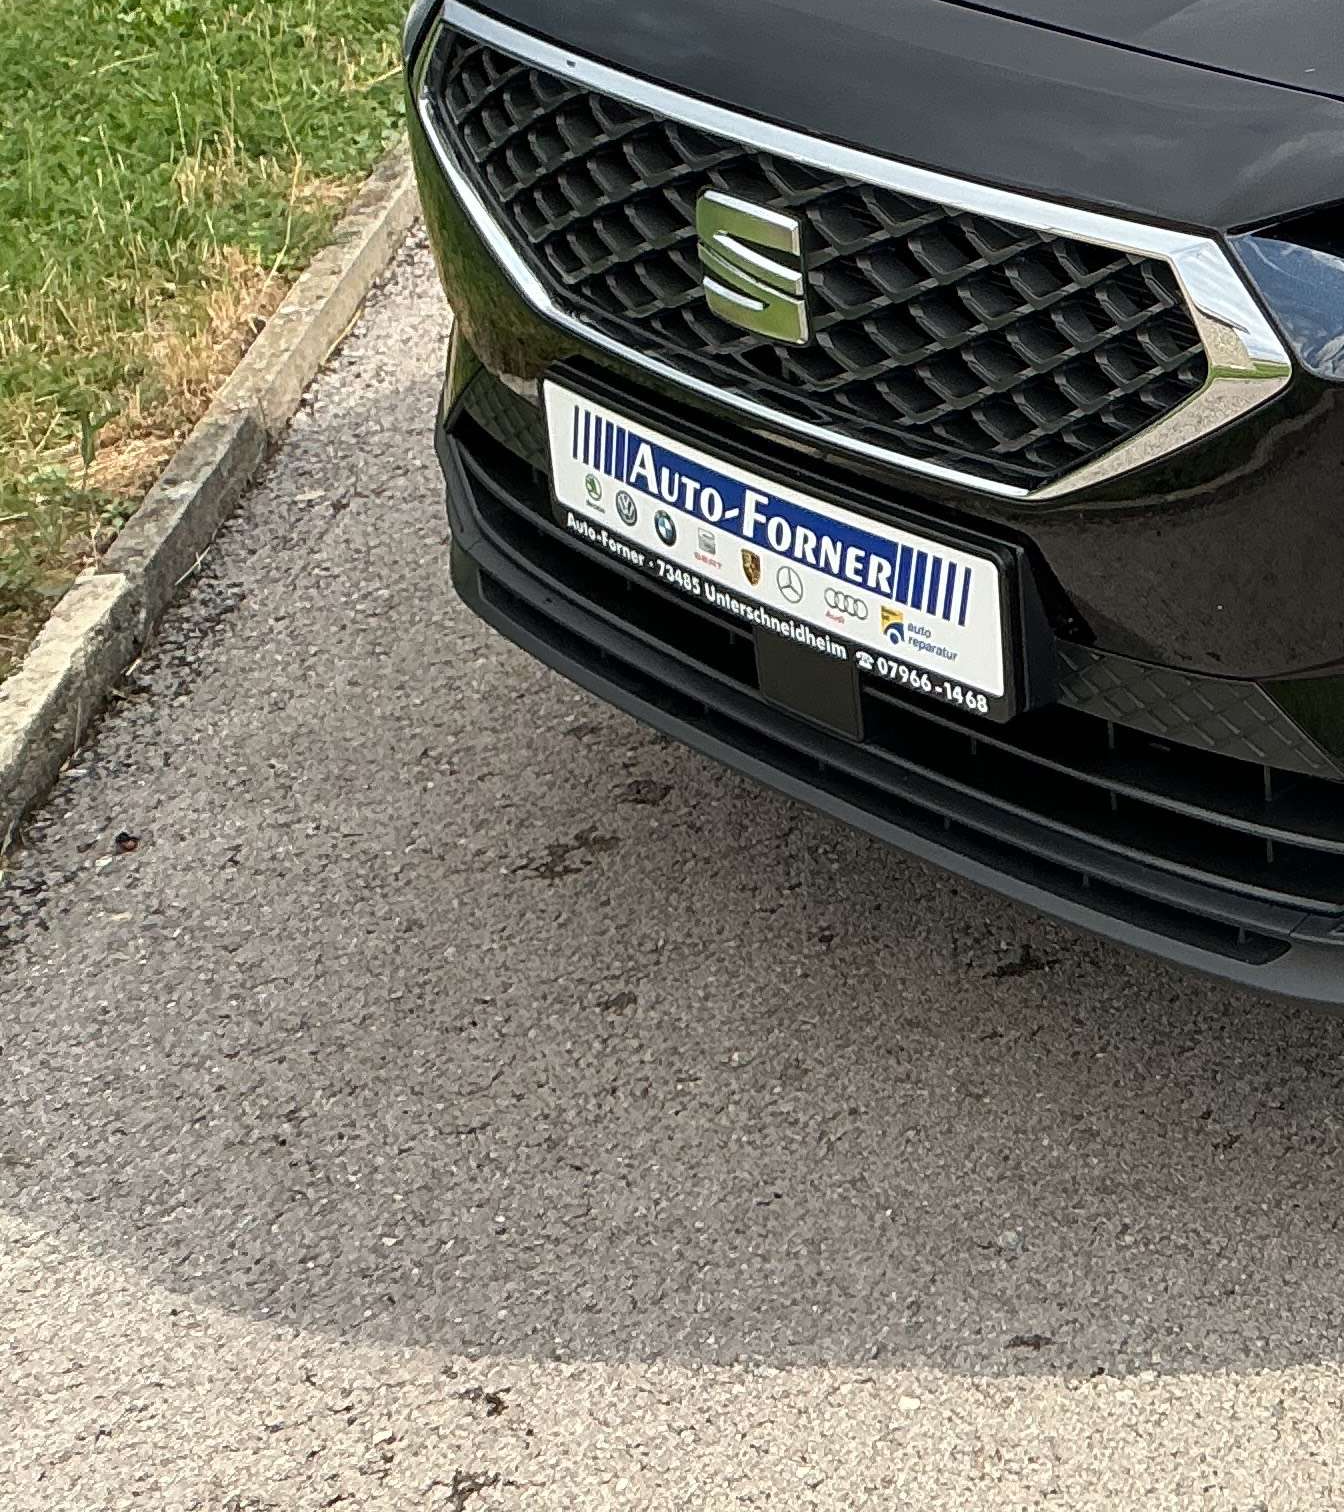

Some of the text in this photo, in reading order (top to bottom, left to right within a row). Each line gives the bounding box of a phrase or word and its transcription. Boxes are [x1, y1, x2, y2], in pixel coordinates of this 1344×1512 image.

[566, 512, 645, 568] Auto-Forner
[656, 559, 701, 595] 73485
[704, 584, 848, 661] Unterschneidheim
[907, 622, 931, 638] auto
[908, 638, 958, 661] reparatur
